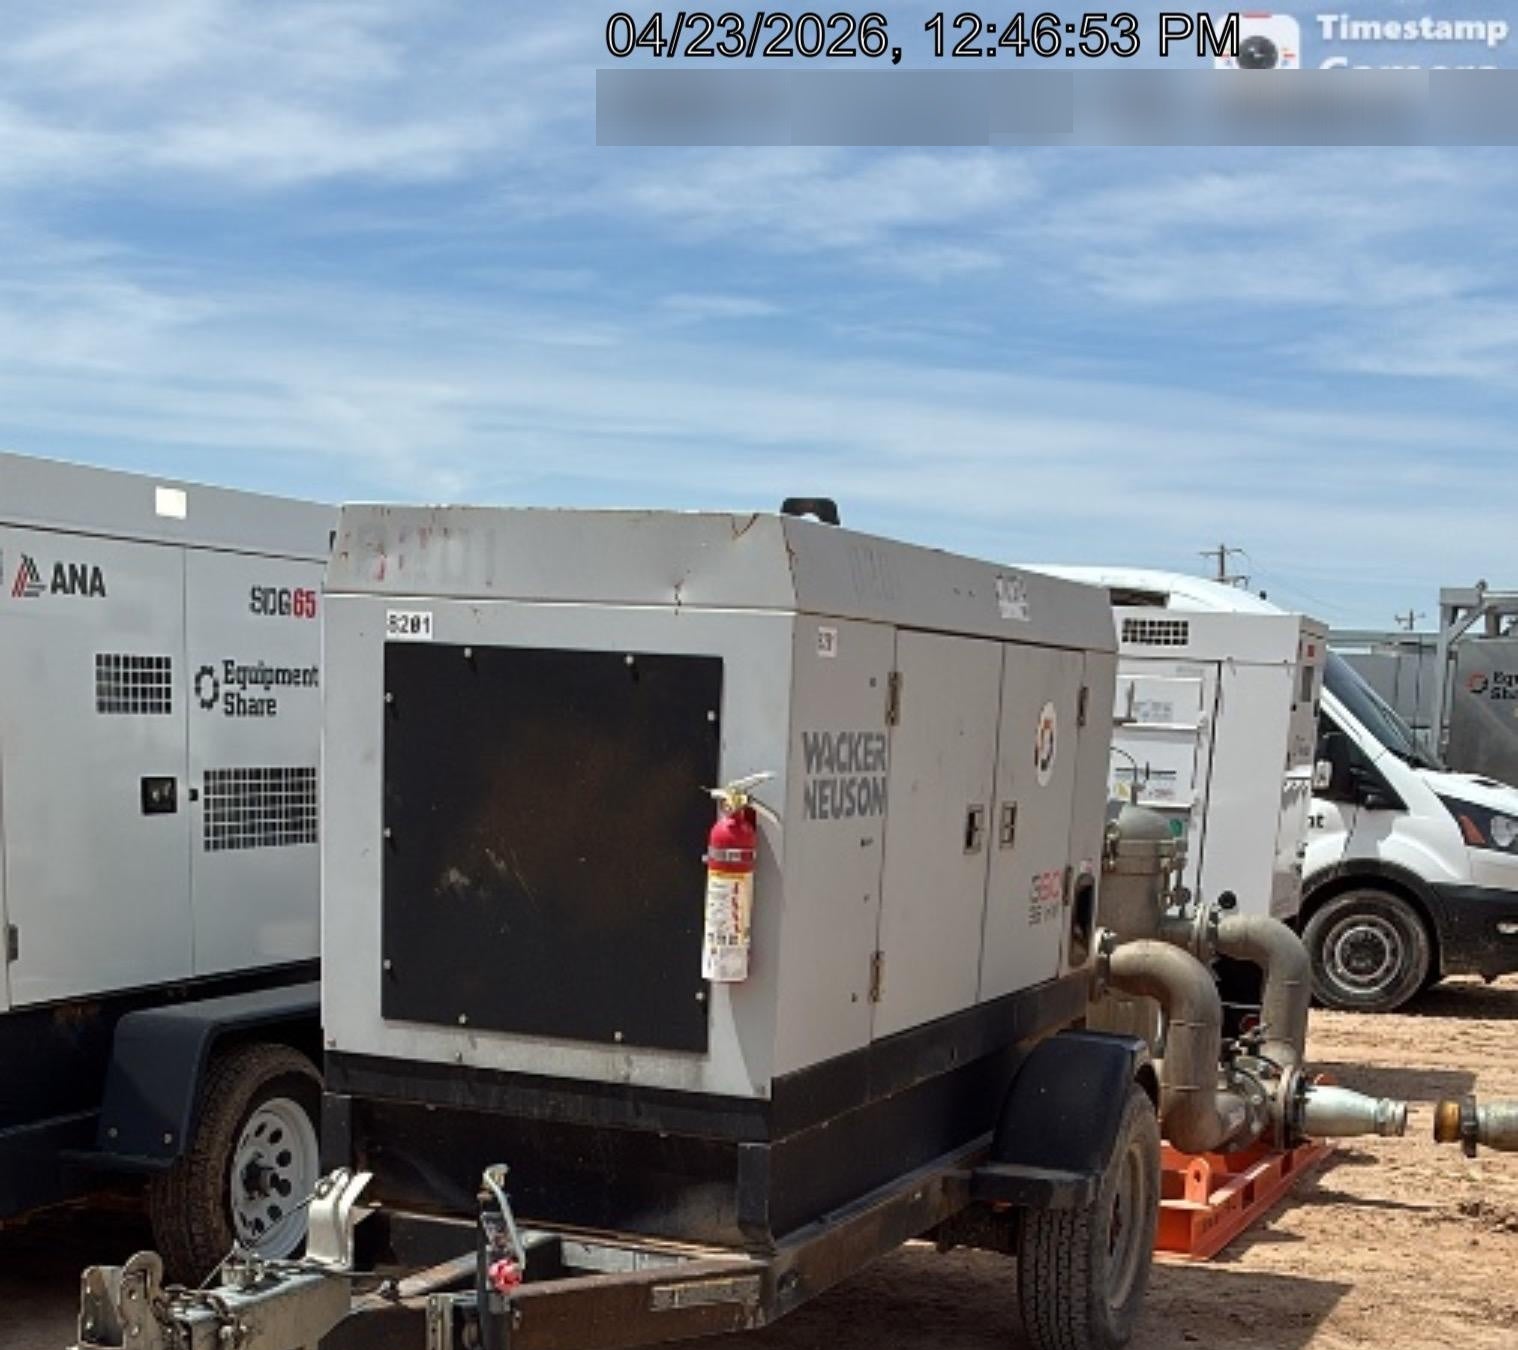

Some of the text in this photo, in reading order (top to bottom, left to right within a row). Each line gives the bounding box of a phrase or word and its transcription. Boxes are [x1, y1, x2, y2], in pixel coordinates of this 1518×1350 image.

[50, 560, 107, 598] ANA
[249, 585, 317, 619] SDG65
[222, 659, 319, 690] Equipment
[223, 692, 277, 717] Share
[802, 731, 887, 774] WACKER
[804, 777, 888, 820] NEUSON
